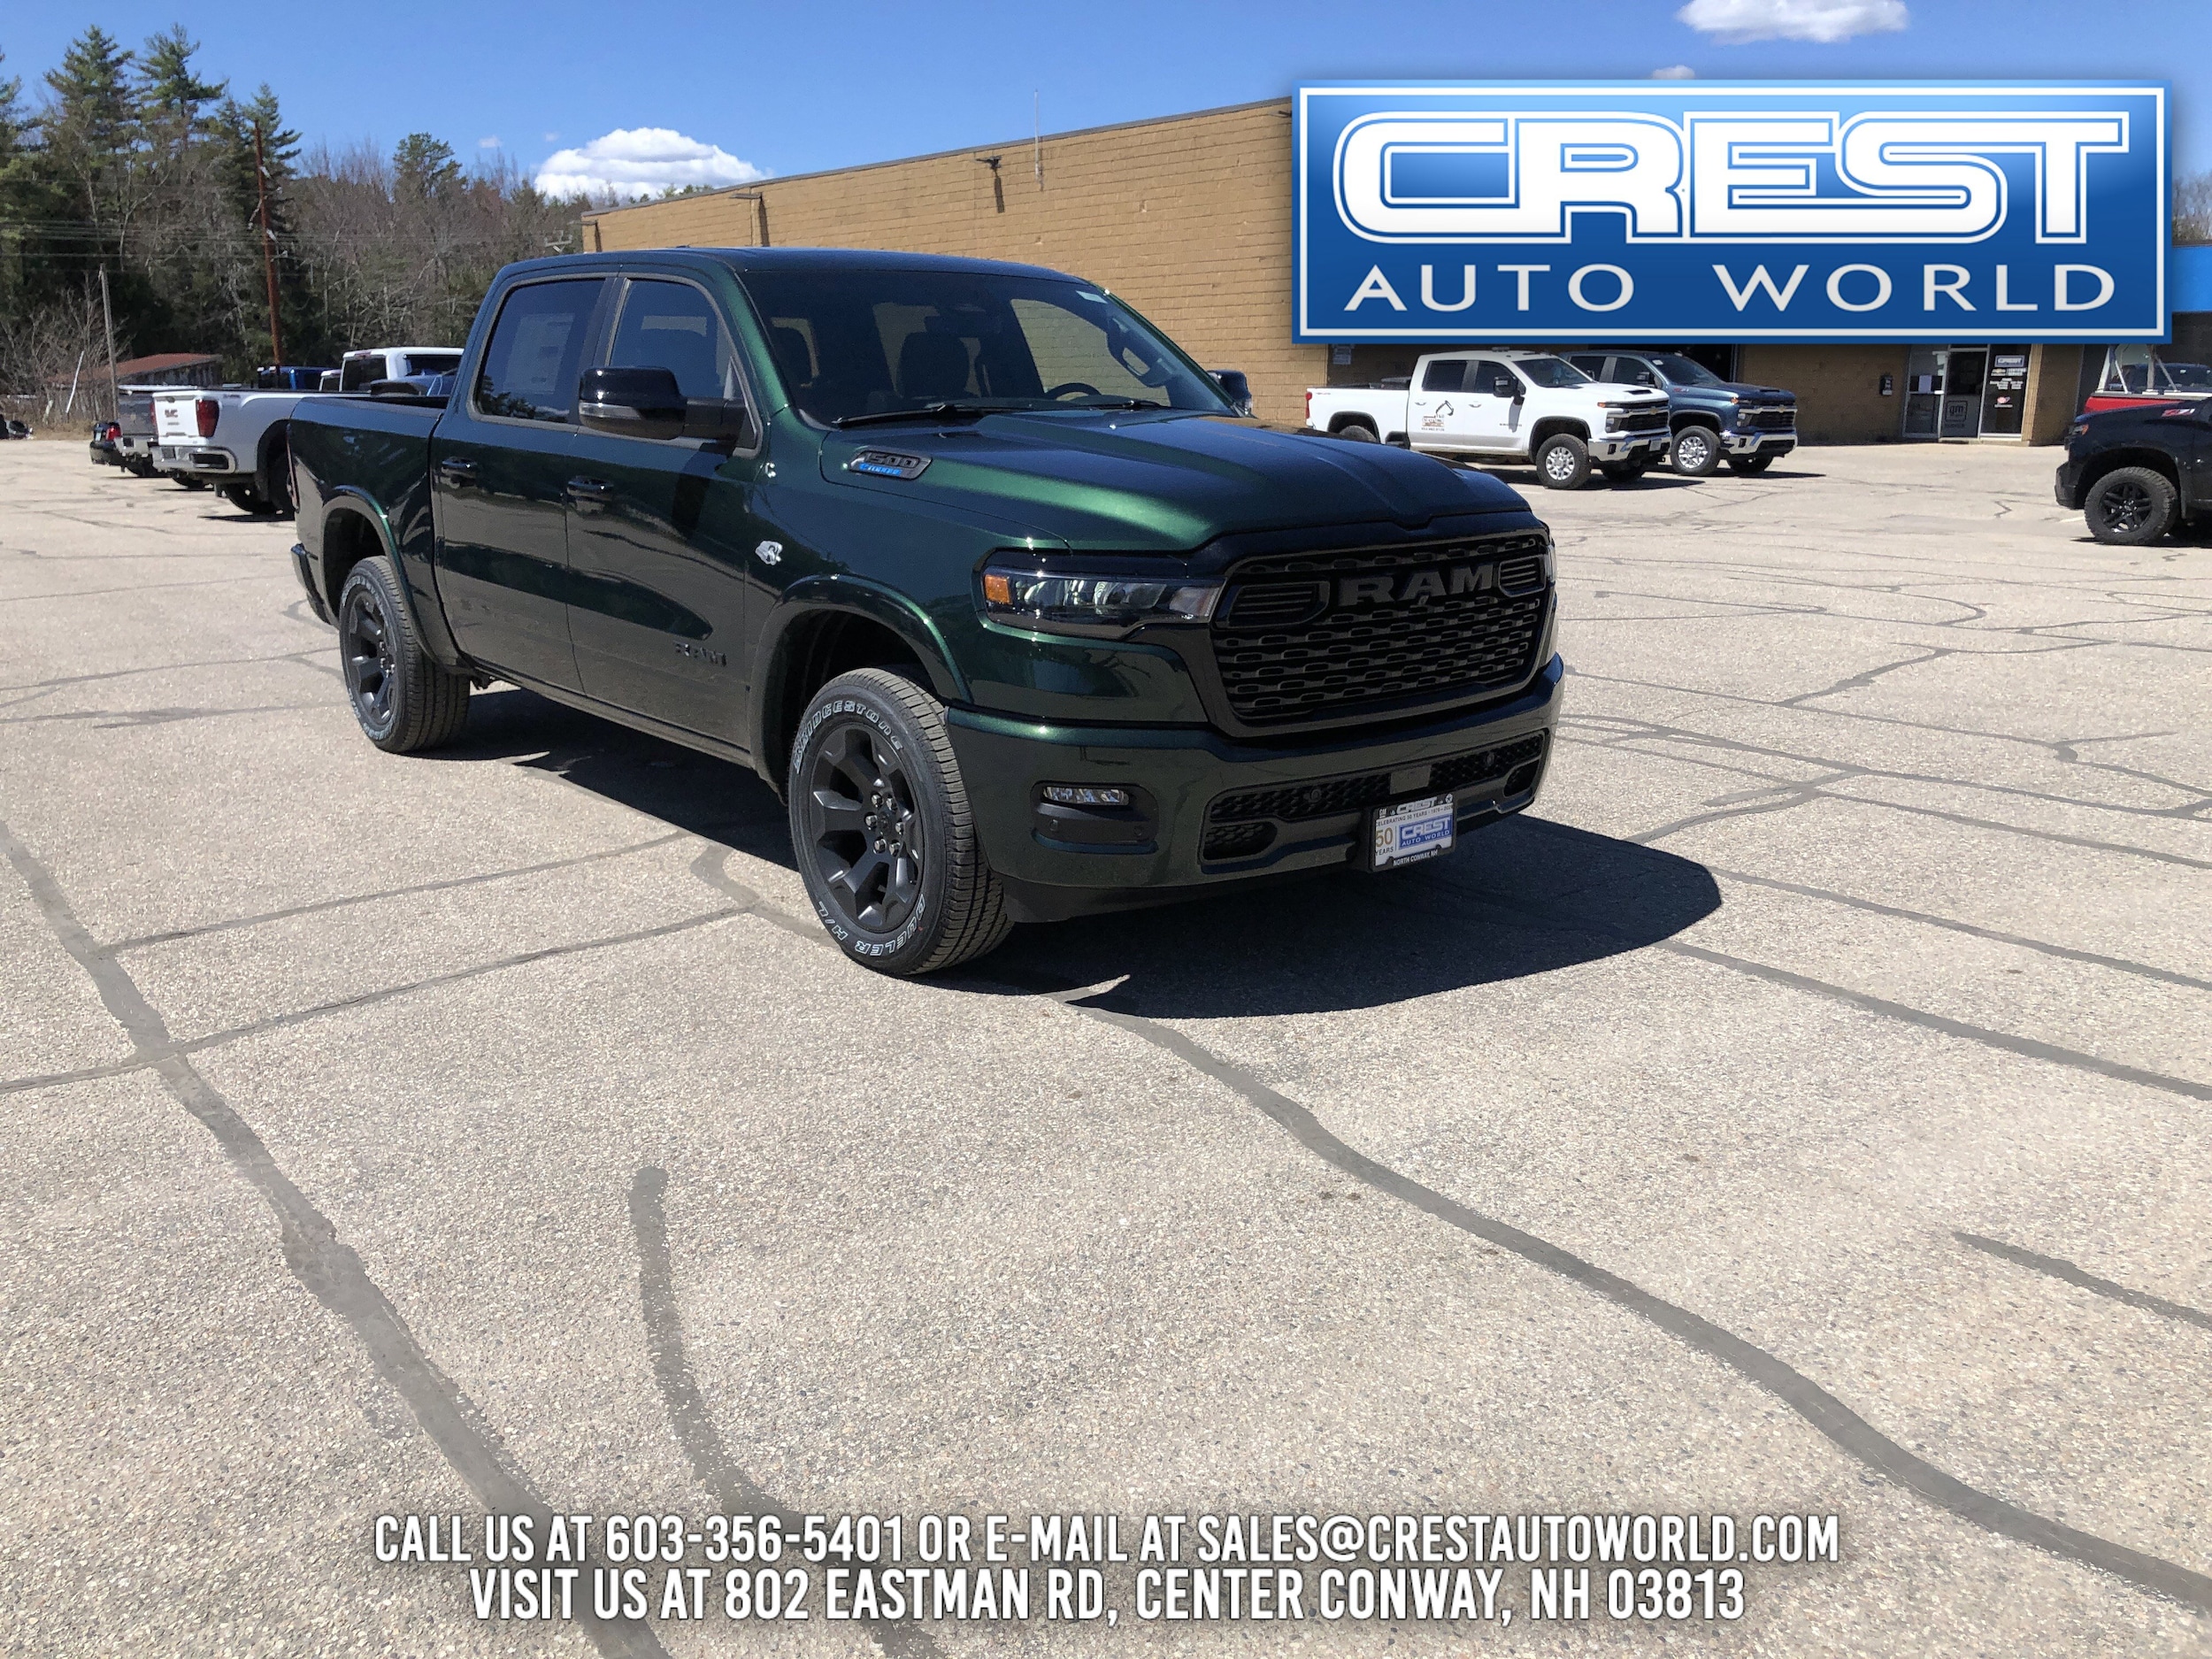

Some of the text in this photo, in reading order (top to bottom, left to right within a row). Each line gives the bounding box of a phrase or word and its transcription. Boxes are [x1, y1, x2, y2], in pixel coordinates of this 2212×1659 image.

[1339, 563, 1494, 607] RAM
[793, 700, 903, 774] BRIDGESTONE
[1396, 796, 1437, 814] CREST
[1376, 827, 1393, 848] 50
[1401, 818, 1450, 840] CREST
[1402, 830, 1449, 847] AUTO WORLD
[1376, 846, 1394, 856] YEARS
[855, 894, 926, 956] DUELER
